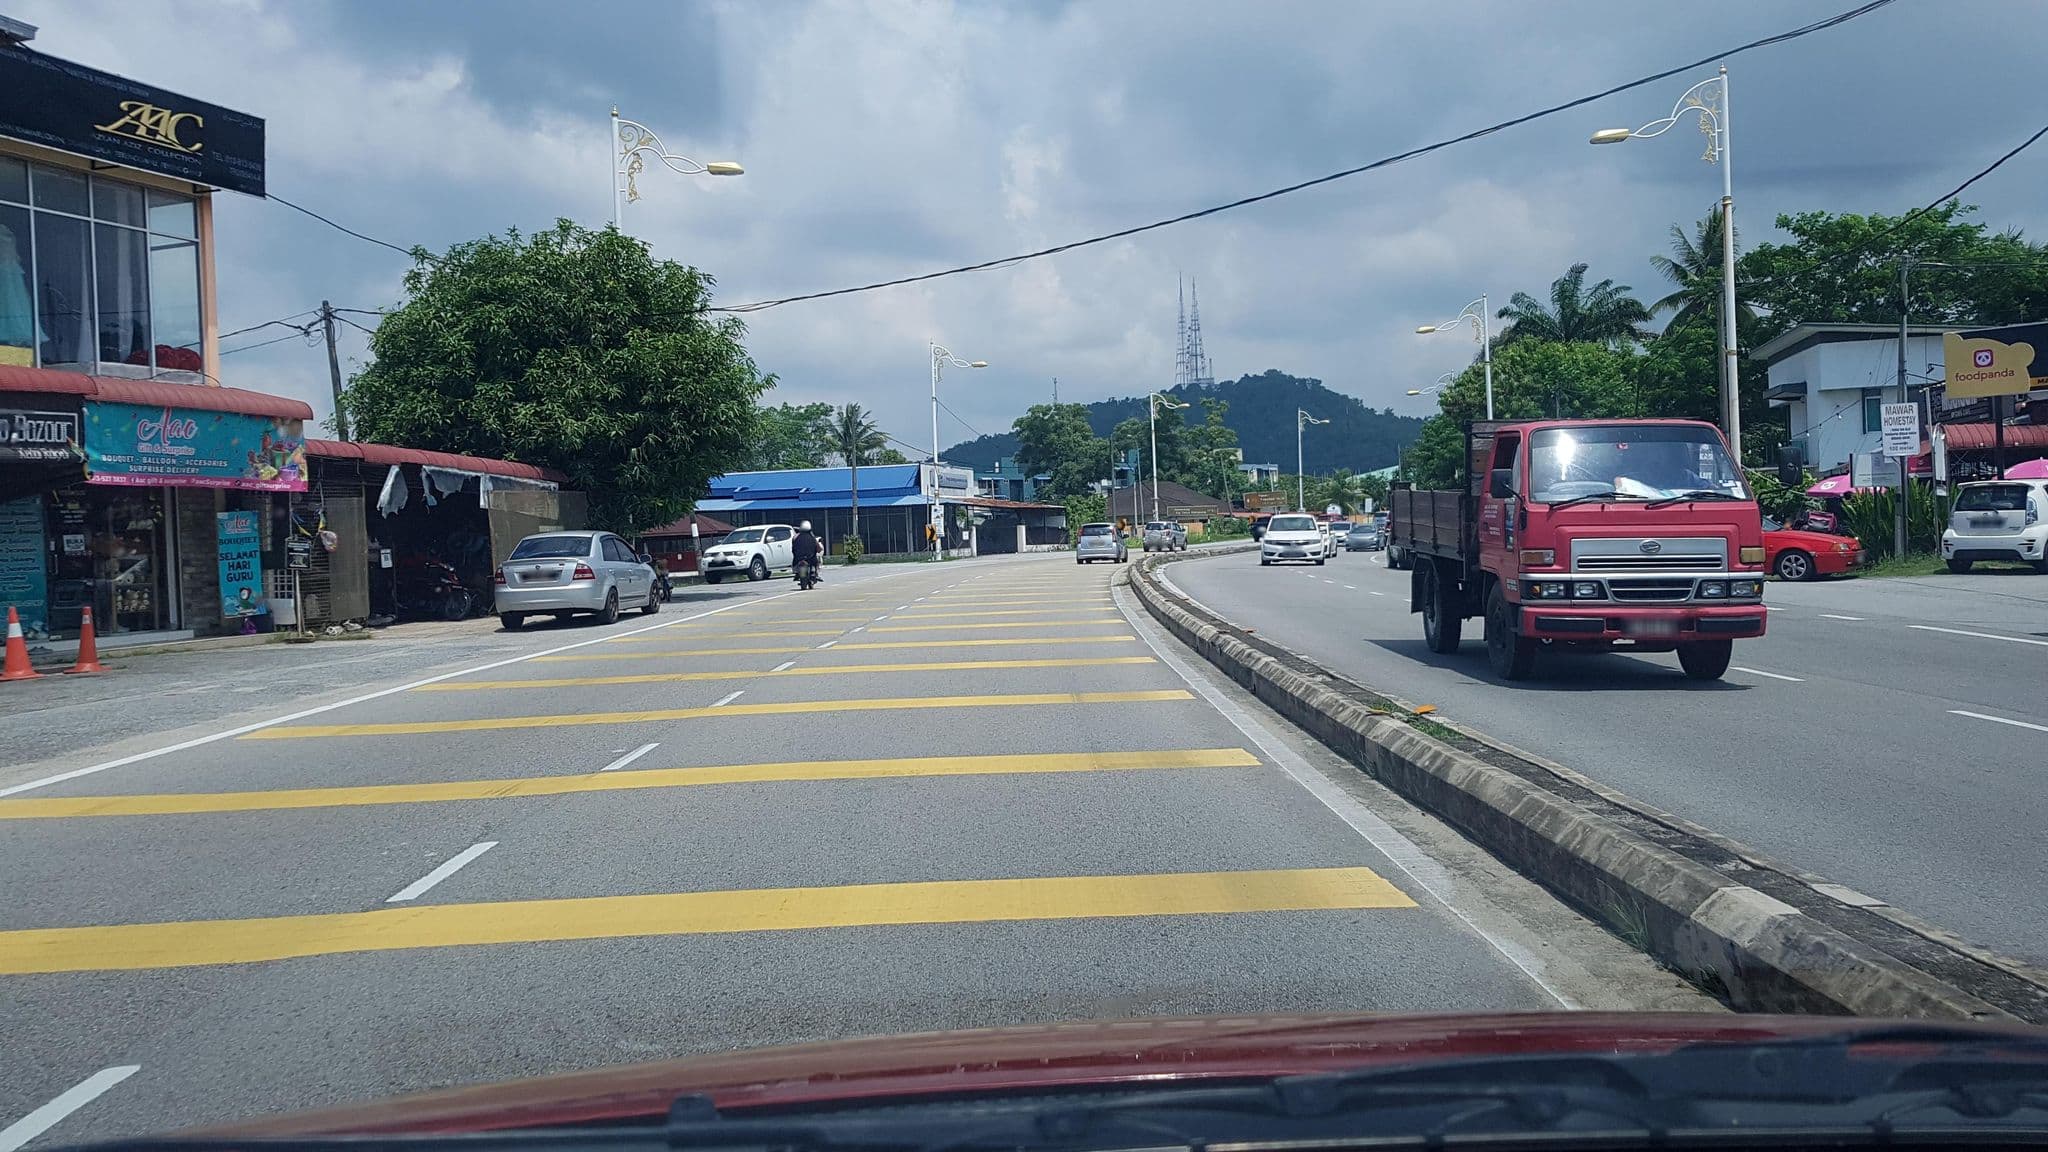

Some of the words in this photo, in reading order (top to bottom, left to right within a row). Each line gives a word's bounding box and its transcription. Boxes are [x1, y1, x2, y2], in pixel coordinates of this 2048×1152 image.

[94, 101, 203, 154] AAC
[1955, 368, 2015, 382] foodpanda
[1885, 404, 1914, 416] MAWAR
[1883, 415, 1917, 427] HOMESTAY
[161, 446, 195, 456] Surprise
[101, 455, 134, 463] BOUQUET
[142, 457, 176, 465] BALLOON
[129, 465, 164, 473] SURPRISE
[219, 536, 257, 545] BOUQUET
[219, 550, 258, 561] SELAMAT
[227, 560, 251, 571] HARI
[226, 571, 254, 582] GURU
